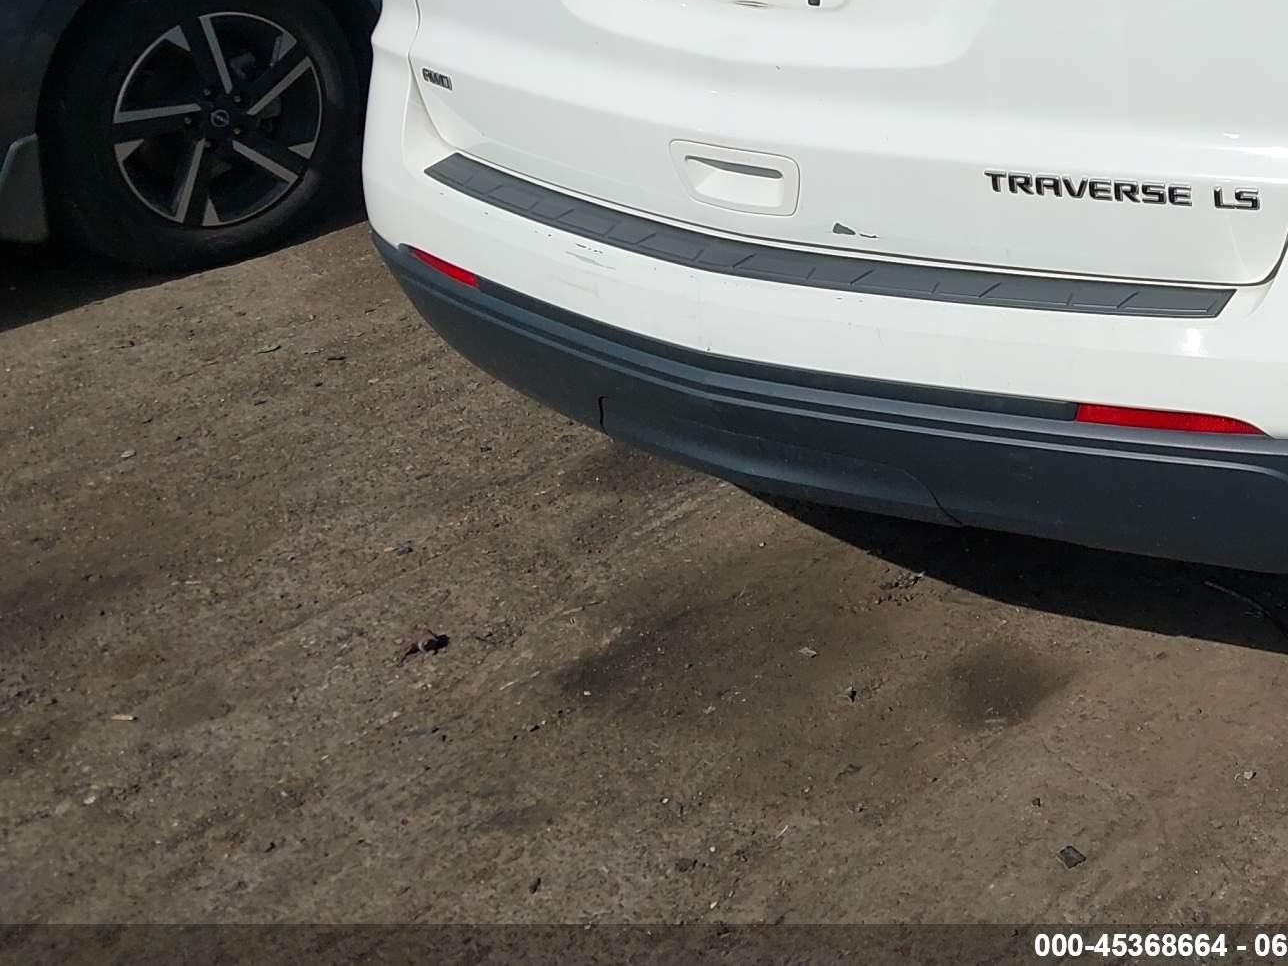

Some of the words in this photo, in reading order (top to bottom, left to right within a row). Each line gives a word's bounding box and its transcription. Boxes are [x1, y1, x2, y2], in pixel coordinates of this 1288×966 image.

[422, 67, 453, 91] AWD
[984, 169, 1193, 207] TRAVERSE
[1213, 185, 1261, 211] LS
